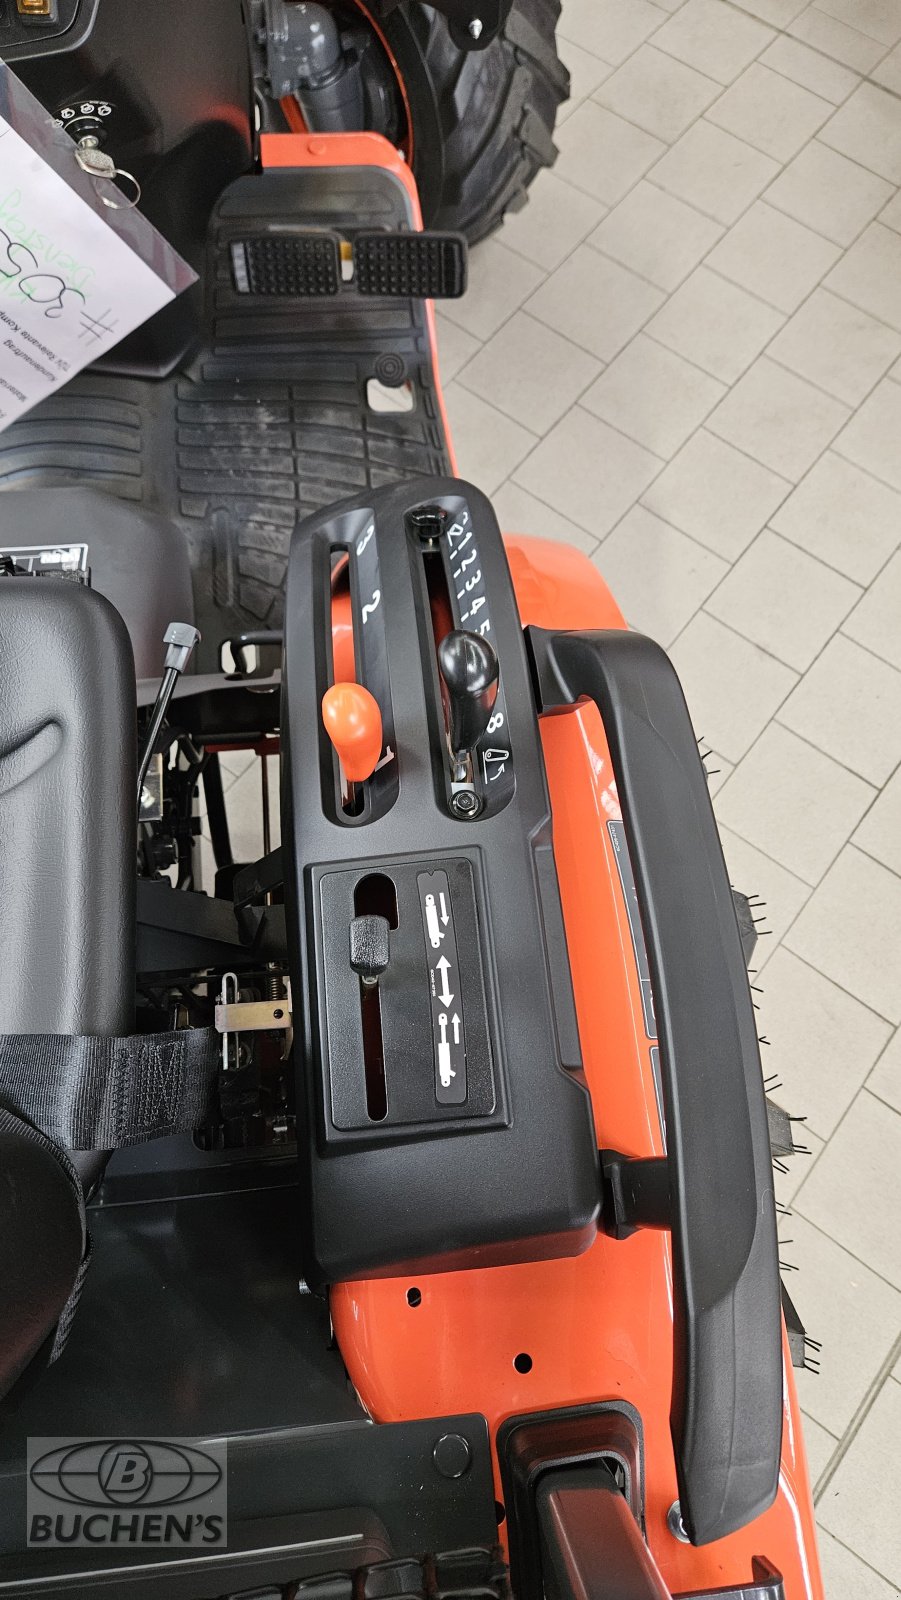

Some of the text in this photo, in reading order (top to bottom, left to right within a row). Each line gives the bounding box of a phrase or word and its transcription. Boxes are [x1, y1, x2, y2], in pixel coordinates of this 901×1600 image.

[356, 525, 375, 556] 3
[458, 532, 472, 550] 1
[461, 549, 477, 572] 2
[465, 569, 481, 591] 3
[362, 589, 381, 624] 2
[470, 596, 486, 615] 4
[486, 712, 504, 734] 8
